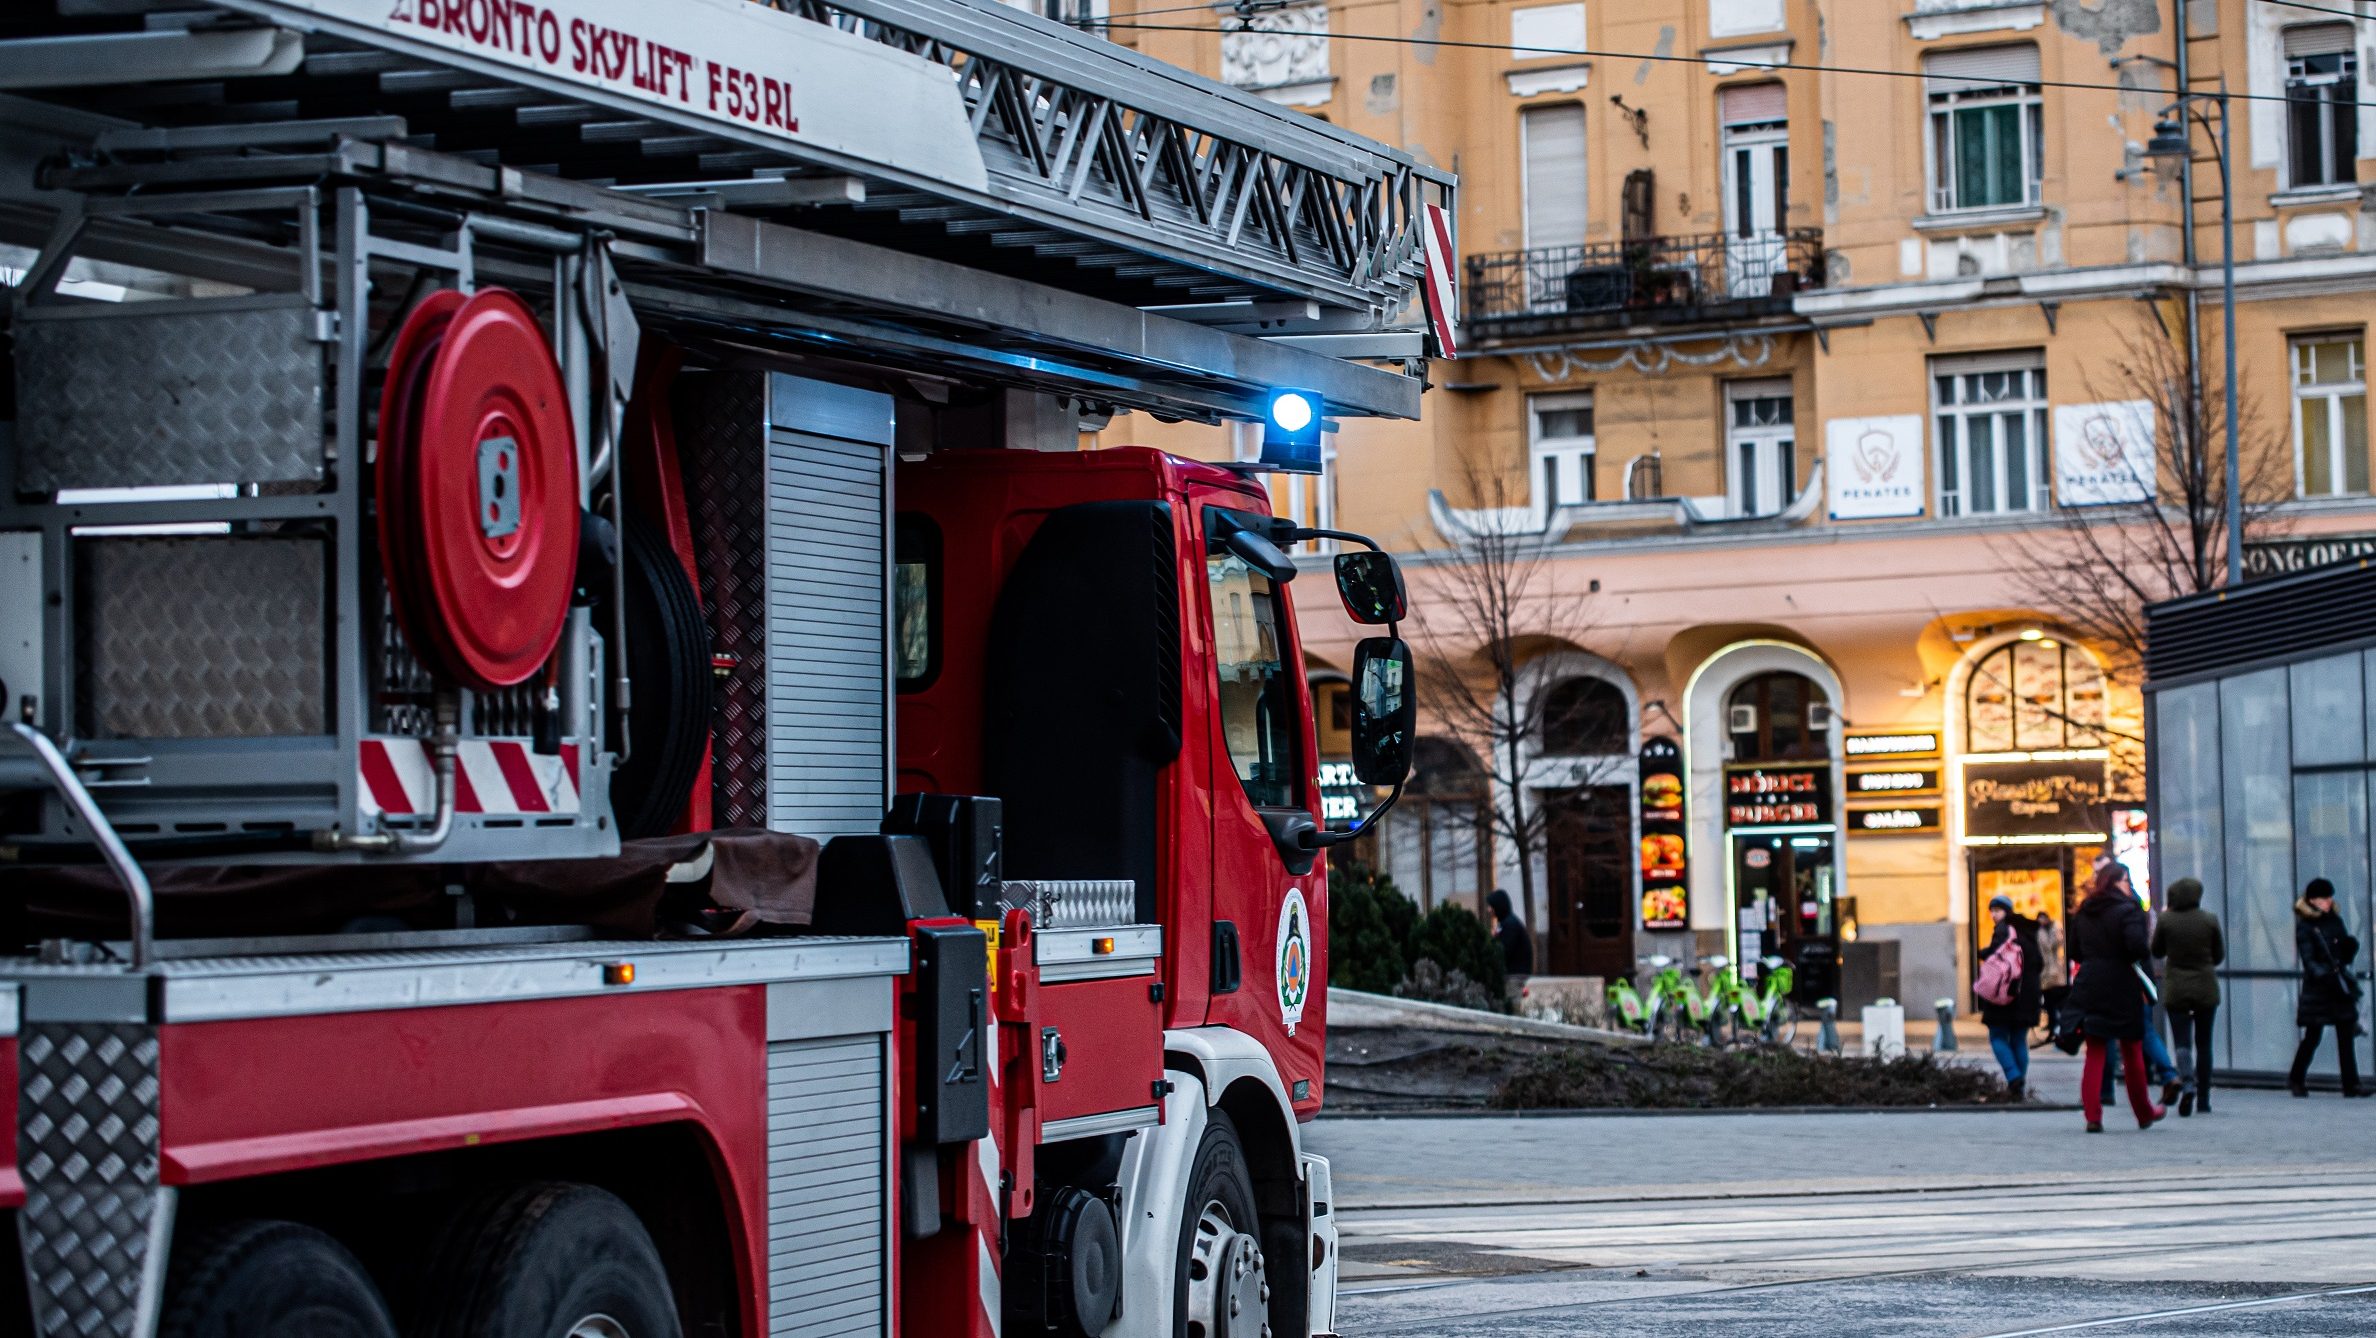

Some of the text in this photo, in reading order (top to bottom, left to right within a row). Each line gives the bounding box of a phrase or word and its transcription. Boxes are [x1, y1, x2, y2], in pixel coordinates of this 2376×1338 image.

[419, 0, 799, 133] BRONTO SKYLIFT F53RL
[1843, 486, 1911, 498] PENATES
[2241, 545, 2304, 573] ONG
